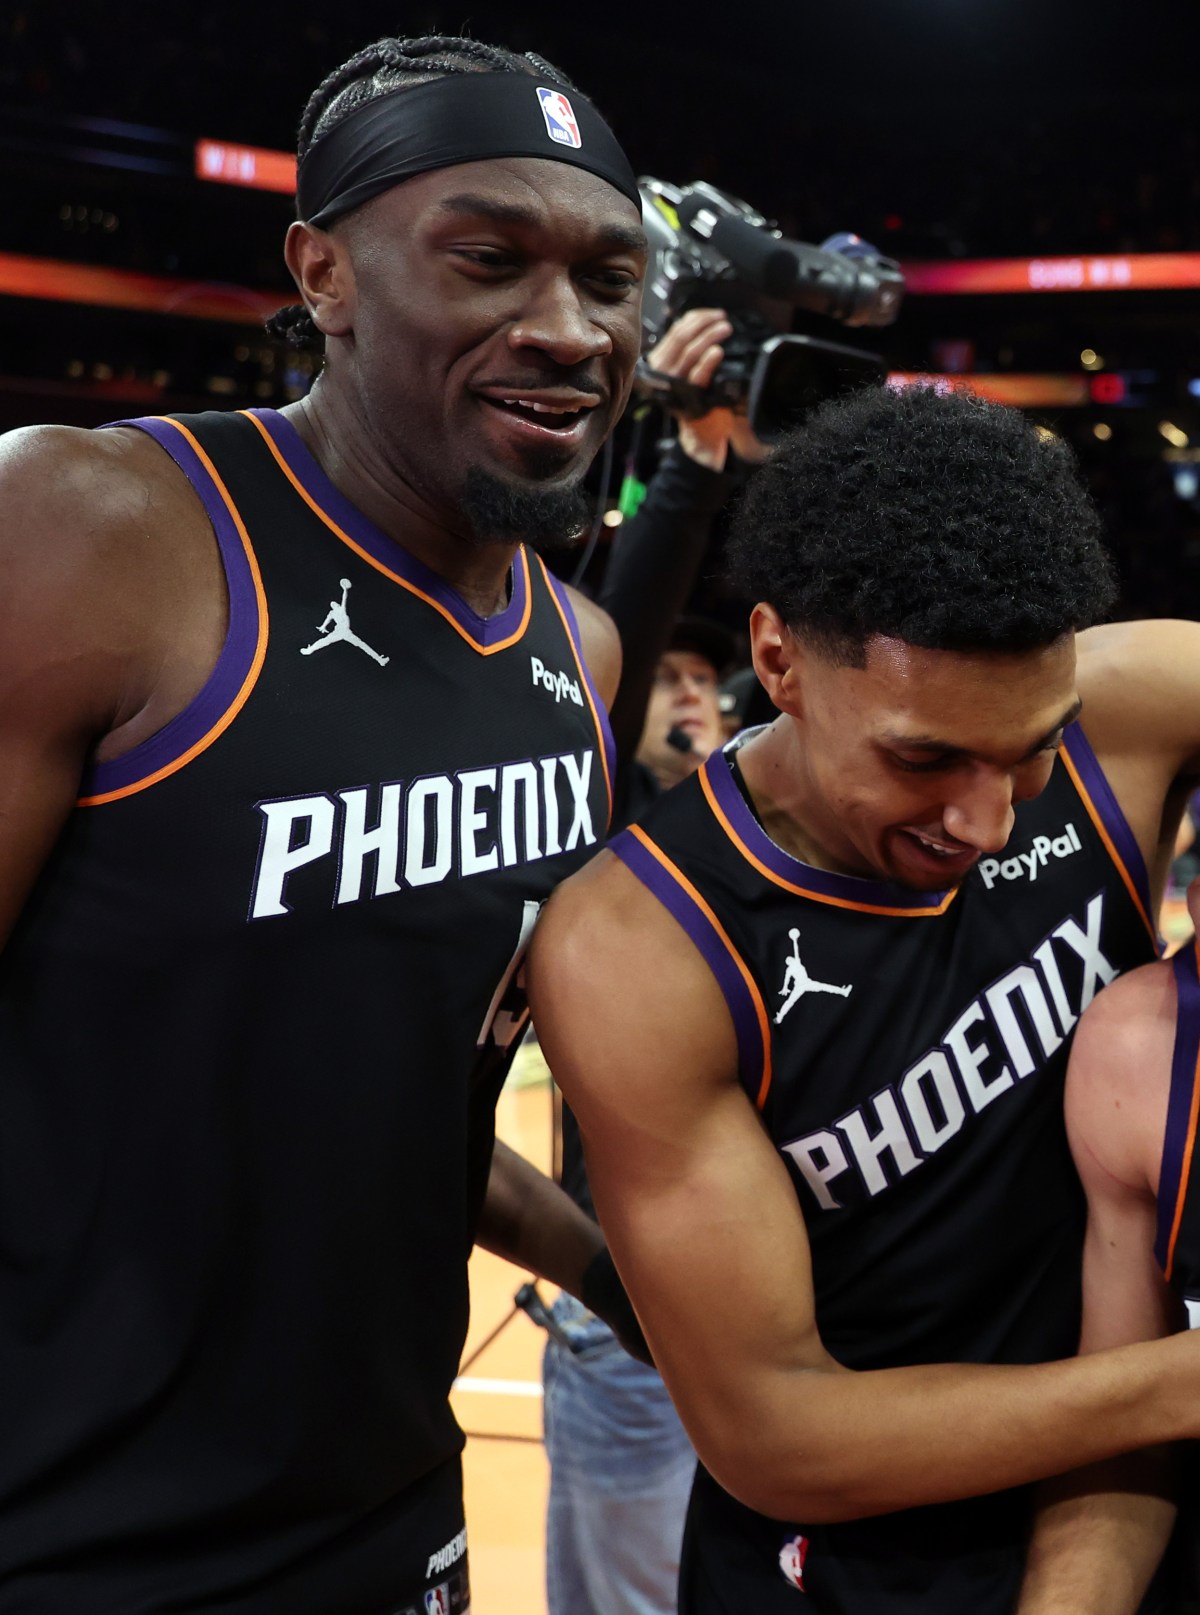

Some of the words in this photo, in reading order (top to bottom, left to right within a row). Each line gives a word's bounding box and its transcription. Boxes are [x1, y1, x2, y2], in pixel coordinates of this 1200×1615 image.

[552, 127, 570, 142] NBA
[530, 656, 585, 707] PayPal
[250, 748, 598, 920] PHOENIX
[978, 823, 1082, 889] PayPal
[782, 893, 1120, 1210] PHOENIX
